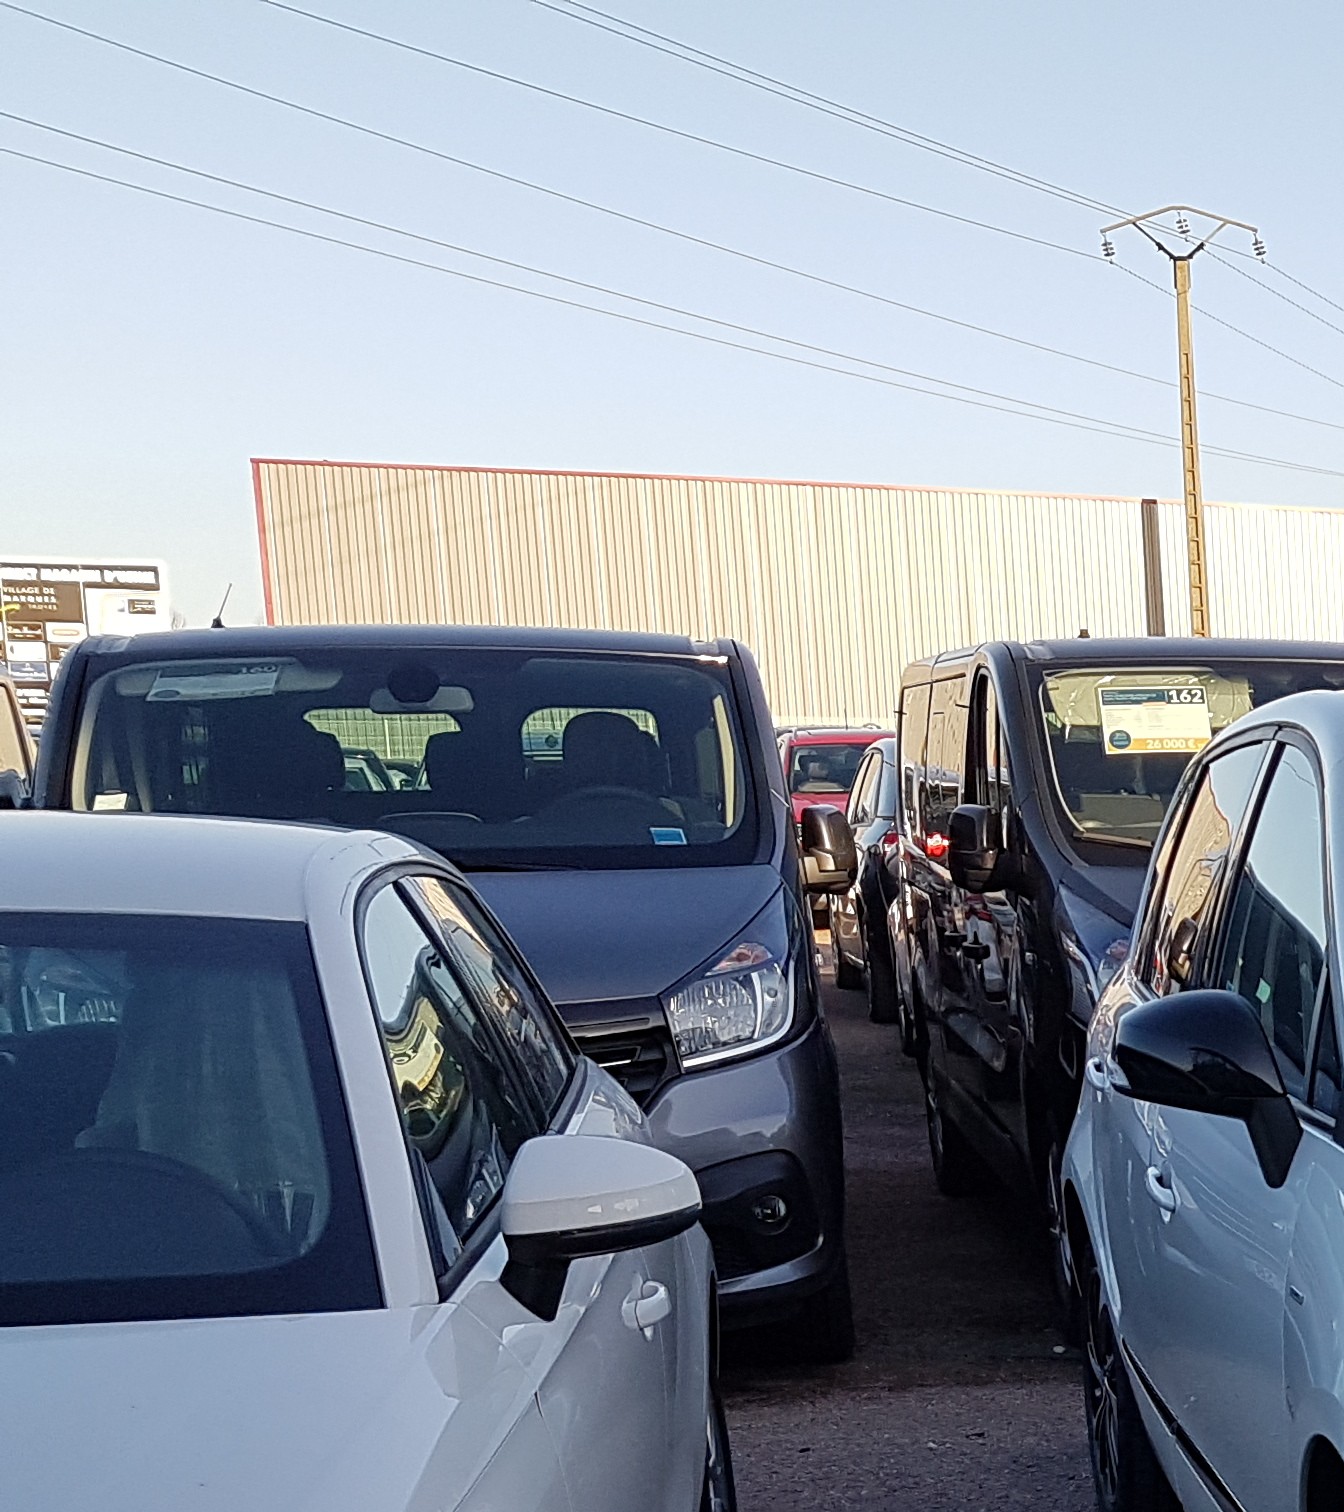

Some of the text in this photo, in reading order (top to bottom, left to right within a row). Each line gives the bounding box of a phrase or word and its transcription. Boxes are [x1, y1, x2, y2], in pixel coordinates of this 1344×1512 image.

[1169, 690, 1203, 703] 162
[1146, 739, 1161, 749] 26
[1163, 739, 1186, 749] 000
